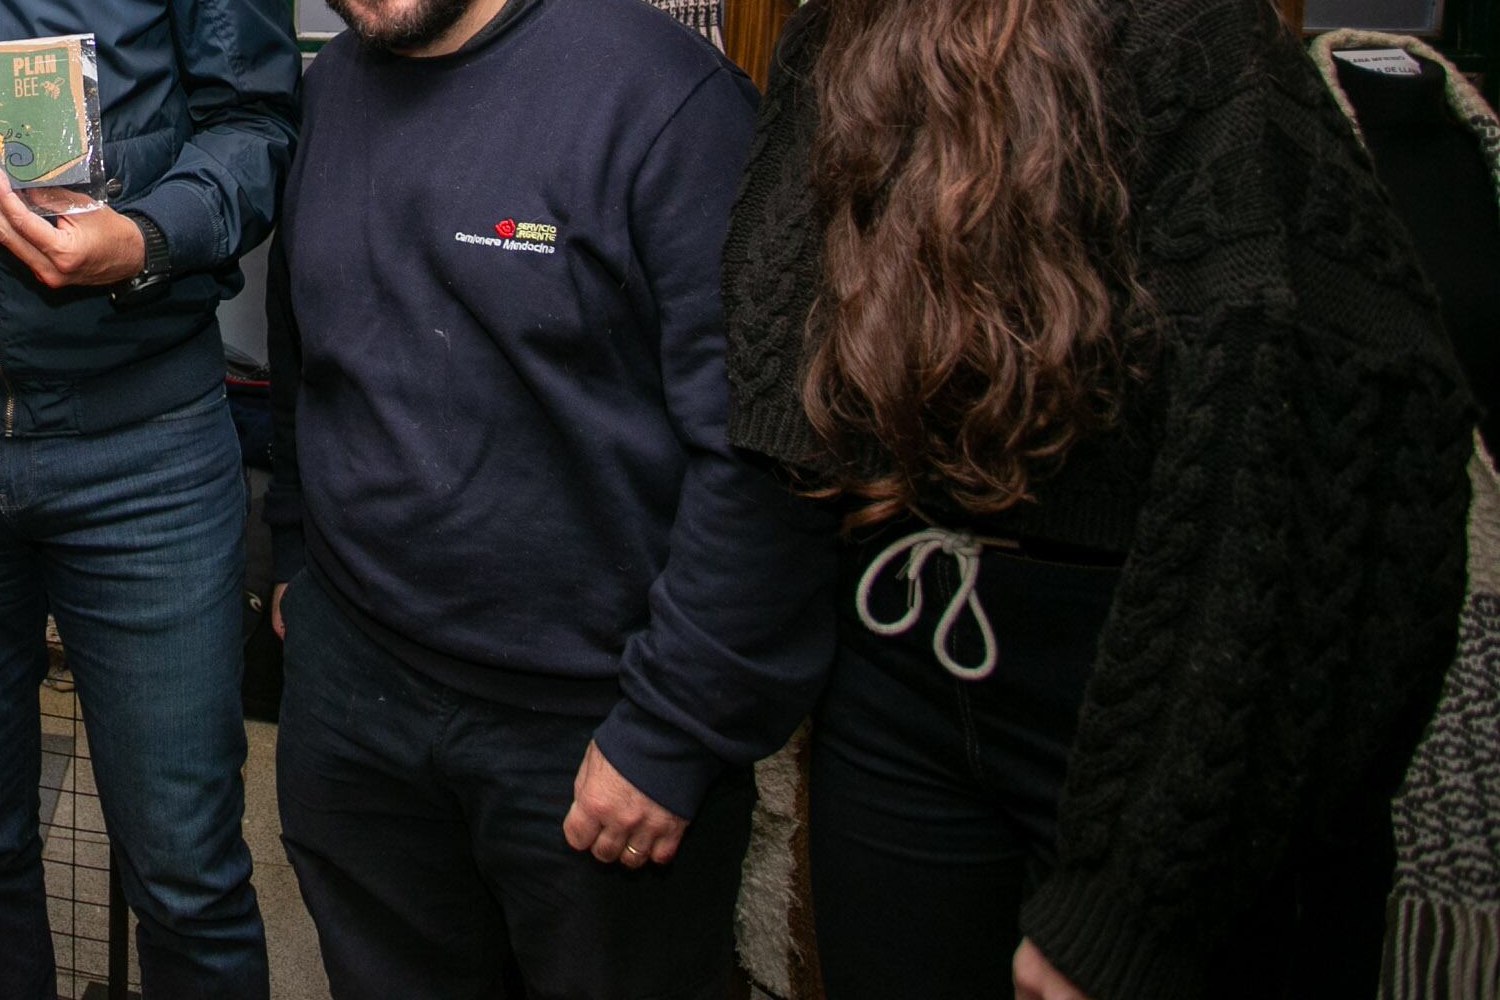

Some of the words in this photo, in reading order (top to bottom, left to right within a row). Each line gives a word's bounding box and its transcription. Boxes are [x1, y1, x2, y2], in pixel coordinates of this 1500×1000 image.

[13, 54, 57, 77] PLAN
[14, 77, 40, 98] BEE
[516, 222, 557, 234] SERVICIO
